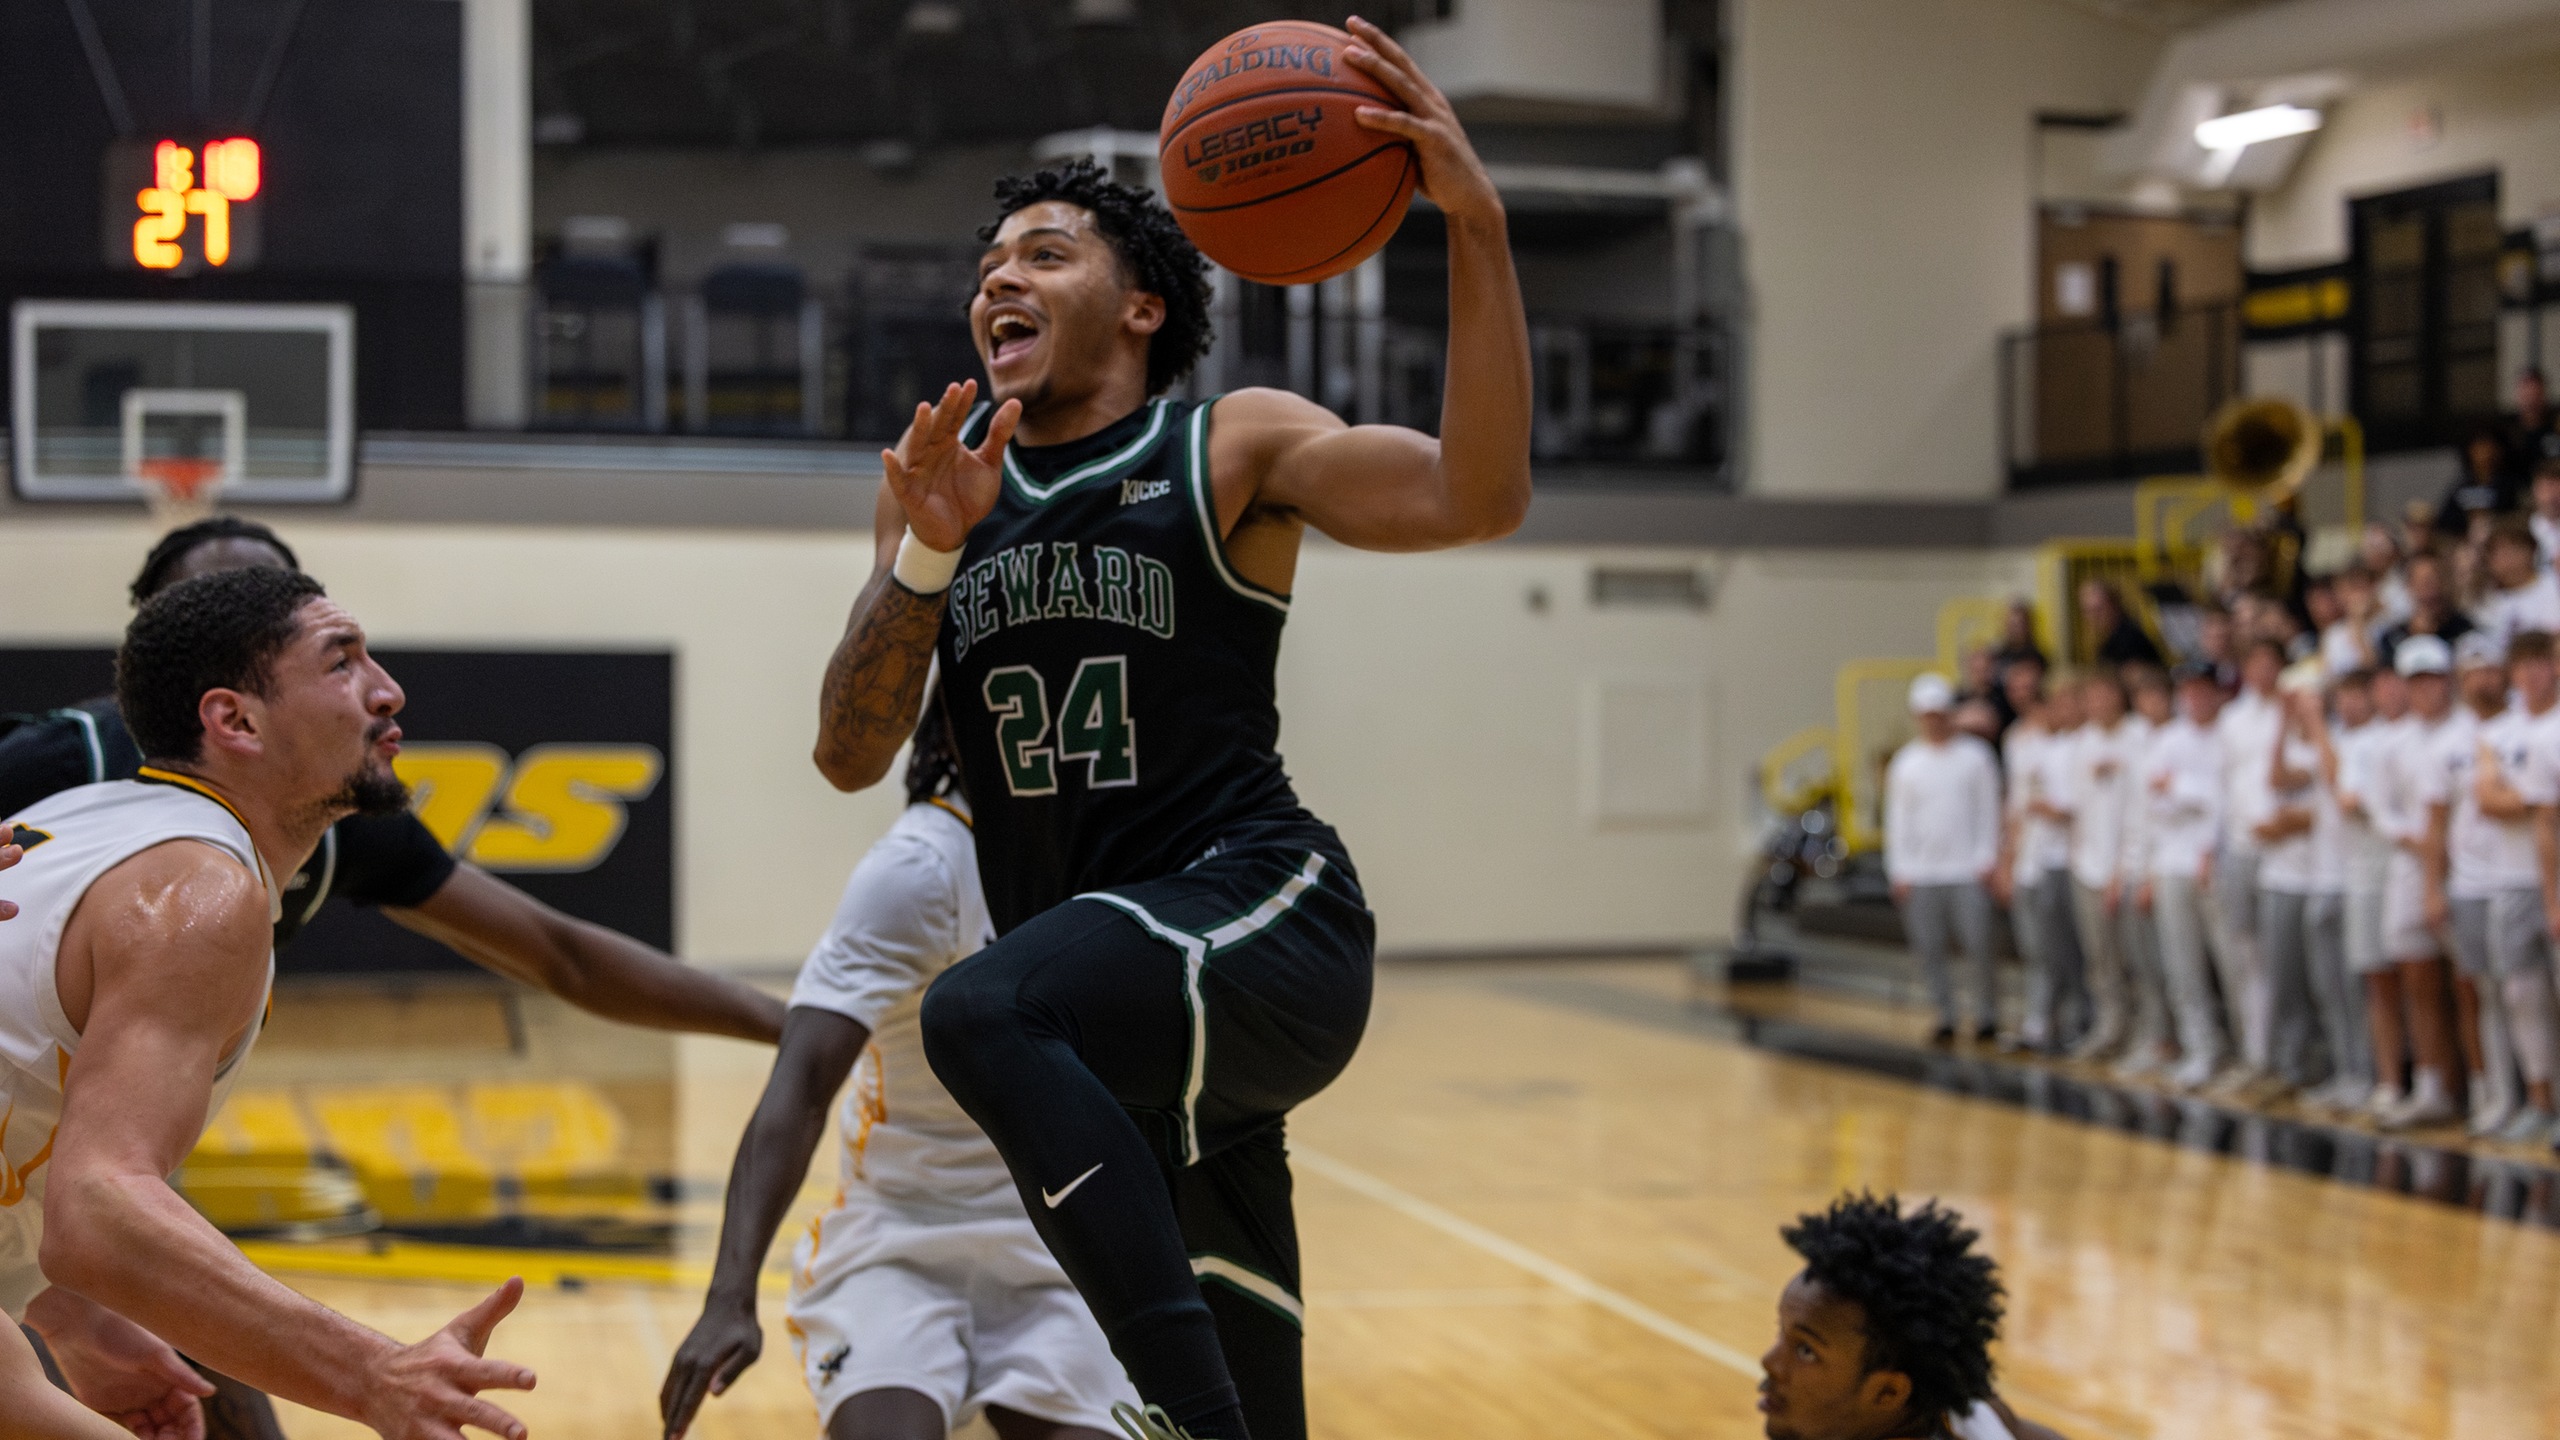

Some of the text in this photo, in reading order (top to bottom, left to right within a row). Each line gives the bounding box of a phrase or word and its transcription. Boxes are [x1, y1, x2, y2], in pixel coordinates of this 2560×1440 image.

[1171, 45, 1333, 122] SPALDING
[1183, 105, 1323, 168] LEGACY
[1225, 138, 1315, 174] 1000
[133, 187, 230, 268] 27
[949, 542, 1175, 663] SEWARD
[982, 655, 1138, 796] 24
